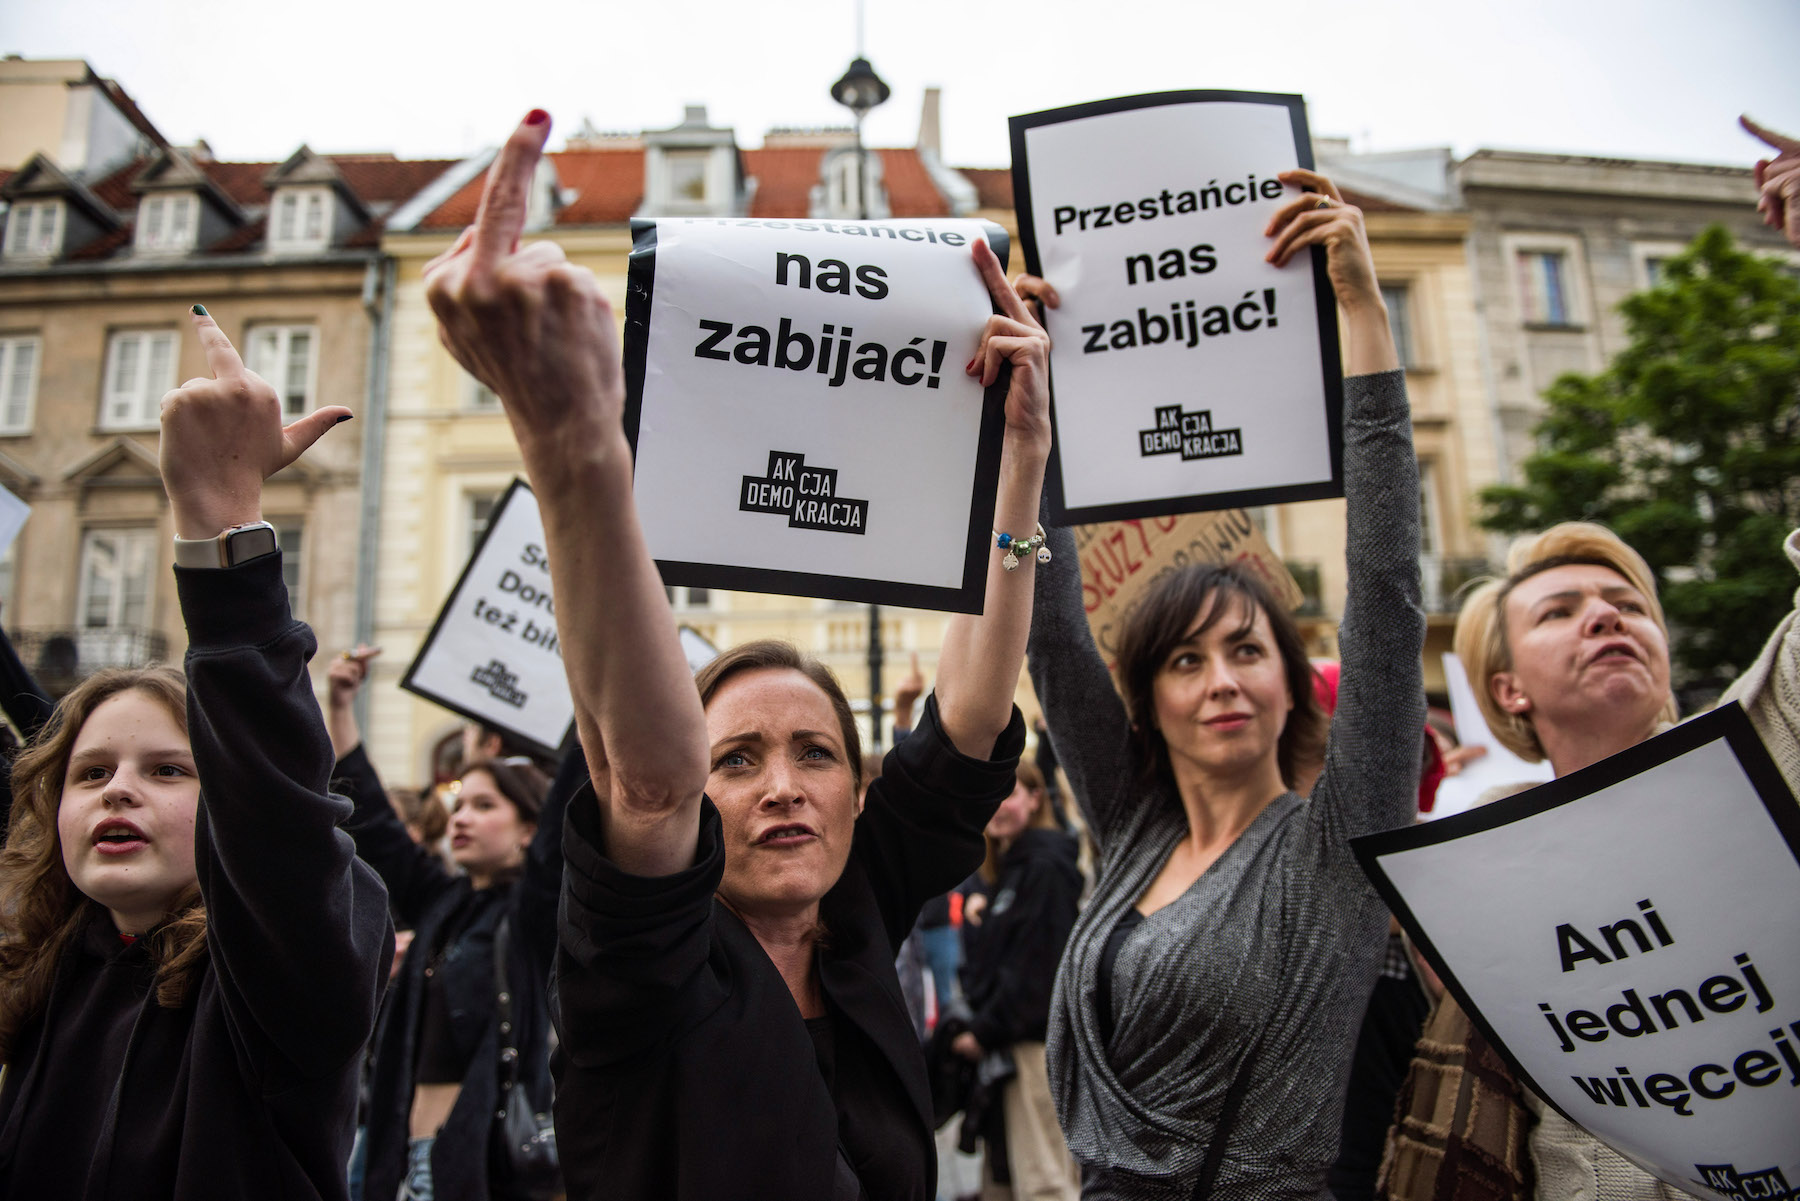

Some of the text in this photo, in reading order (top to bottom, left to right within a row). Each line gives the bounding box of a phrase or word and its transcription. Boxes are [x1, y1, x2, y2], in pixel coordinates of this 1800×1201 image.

[1054, 175, 1284, 235] Przestańcie
[775, 252, 889, 300] nas
[1125, 243, 1218, 286] nas
[694, 317, 947, 389] zabijać!
[1082, 288, 1280, 354] zabijać!
[1555, 898, 1675, 973] Ani
[1538, 953, 1775, 1052] jednej
